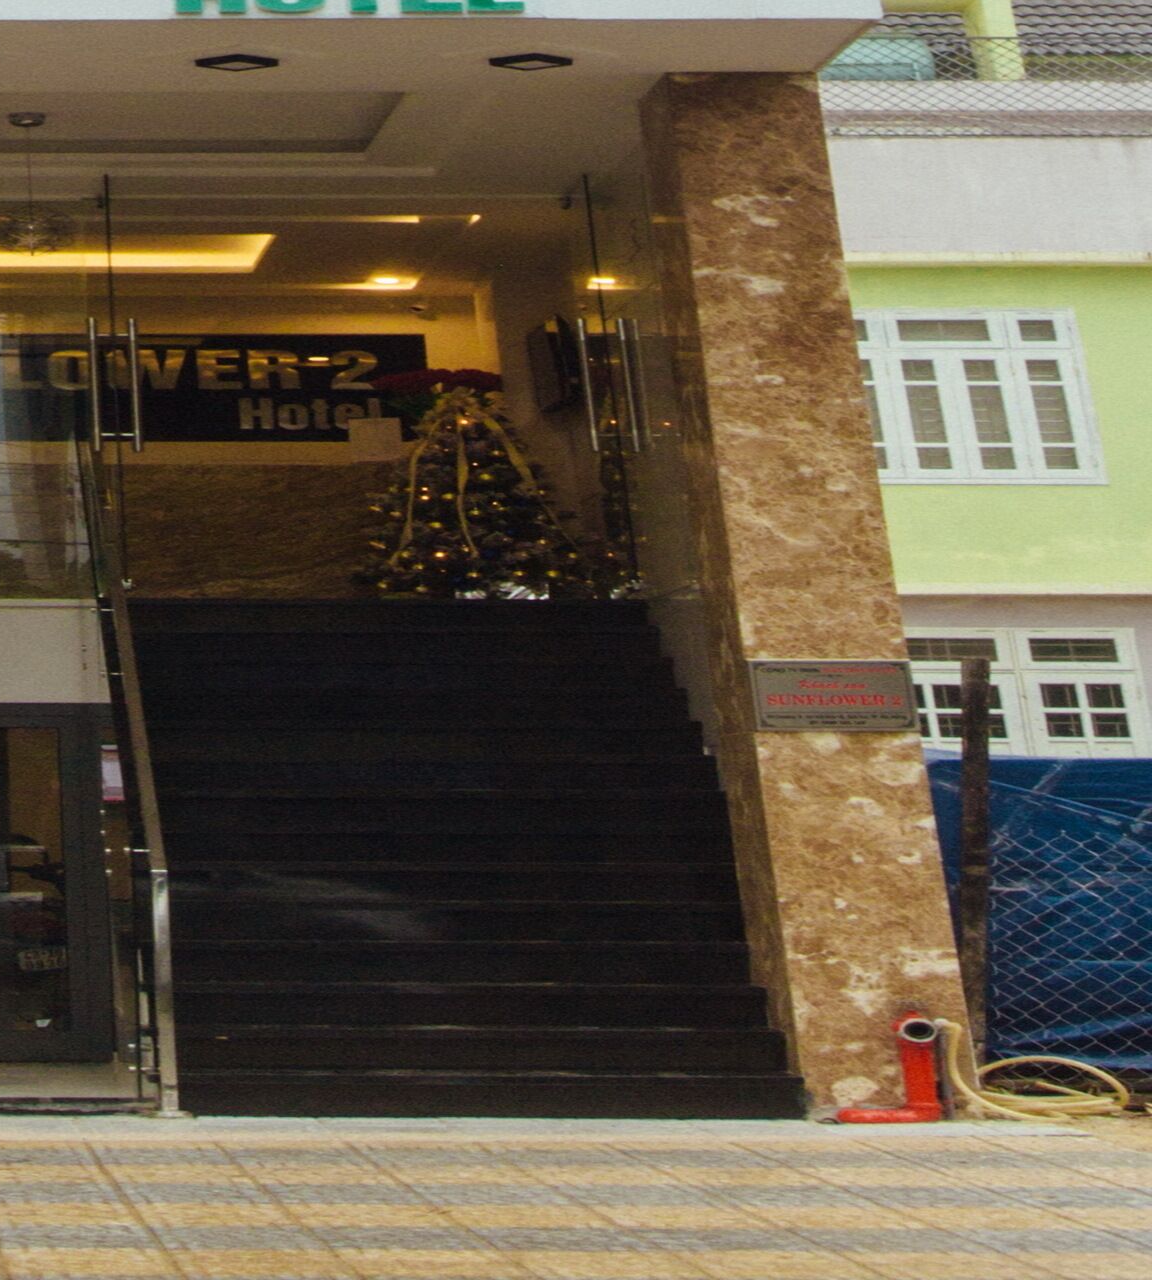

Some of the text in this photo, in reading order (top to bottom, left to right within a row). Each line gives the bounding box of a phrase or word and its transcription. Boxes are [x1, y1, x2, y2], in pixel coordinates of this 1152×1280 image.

[331, 350, 379, 390] 2
[767, 693, 903, 707] SUNFLOWER 2
